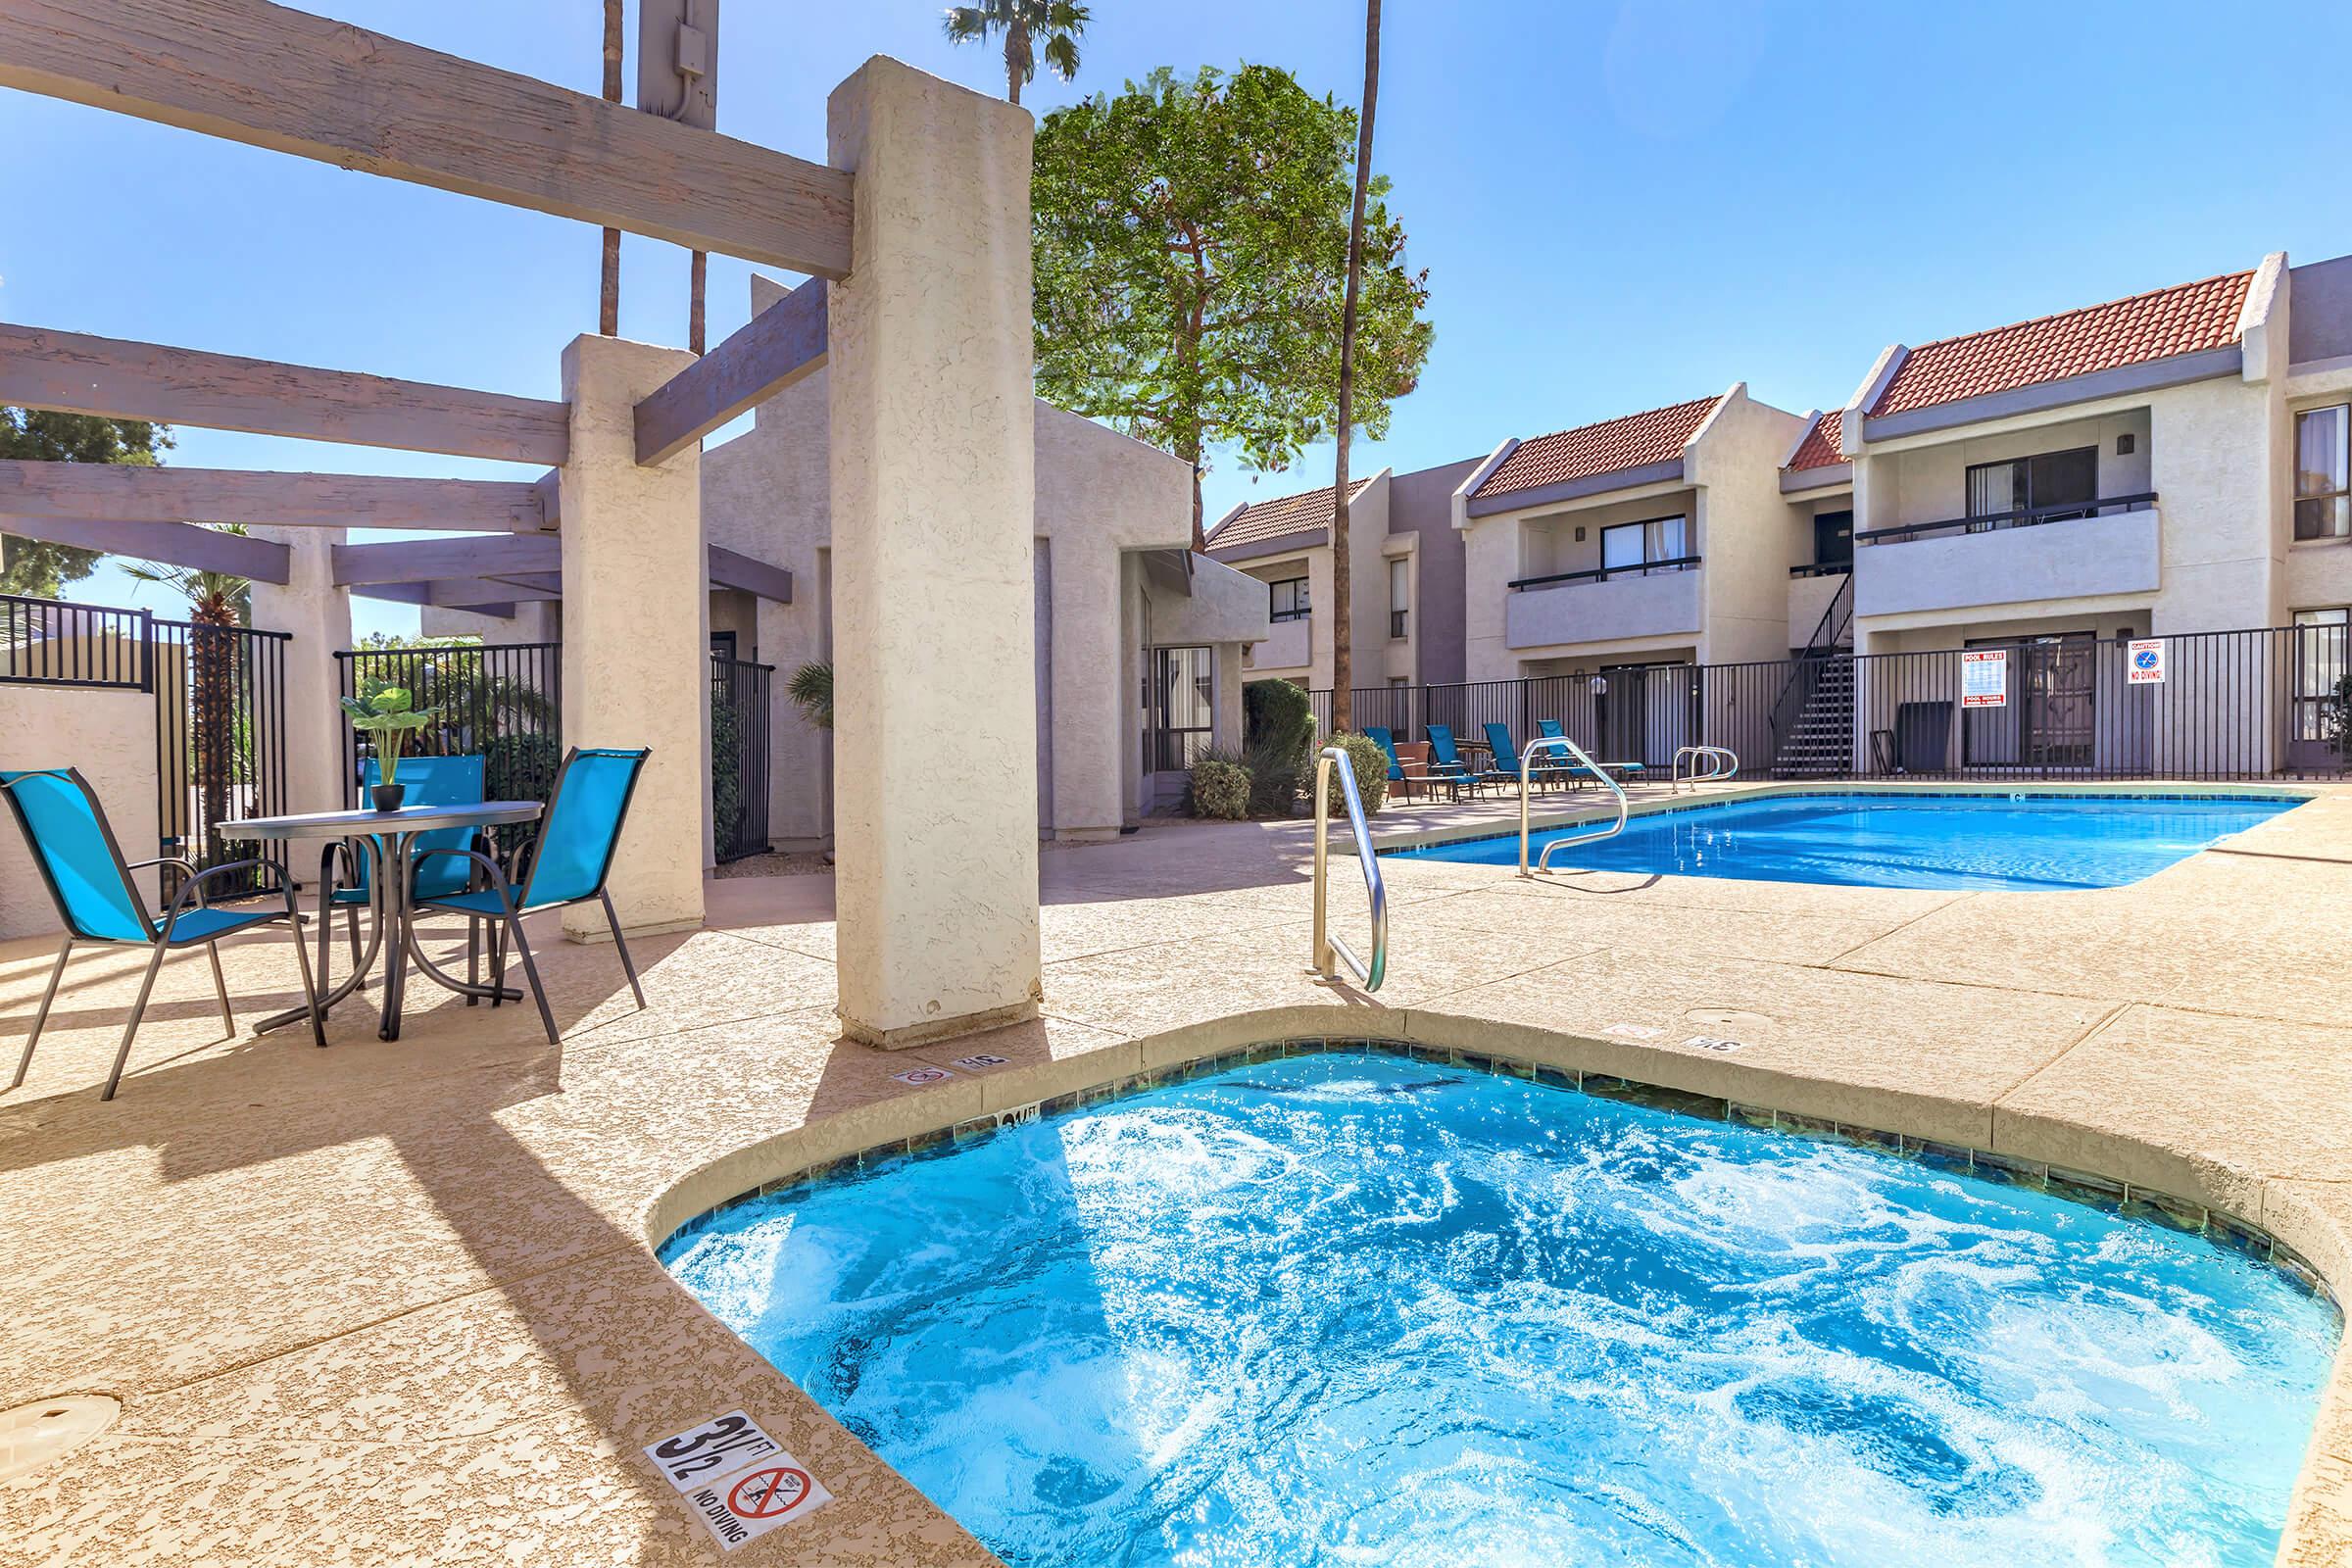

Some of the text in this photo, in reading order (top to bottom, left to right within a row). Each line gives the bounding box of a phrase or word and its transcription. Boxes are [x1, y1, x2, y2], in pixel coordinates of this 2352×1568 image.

[2132, 671, 2139, 680] NO
[747, 1441, 775, 1457] FT
[693, 1489, 749, 1544] NO DIVING
